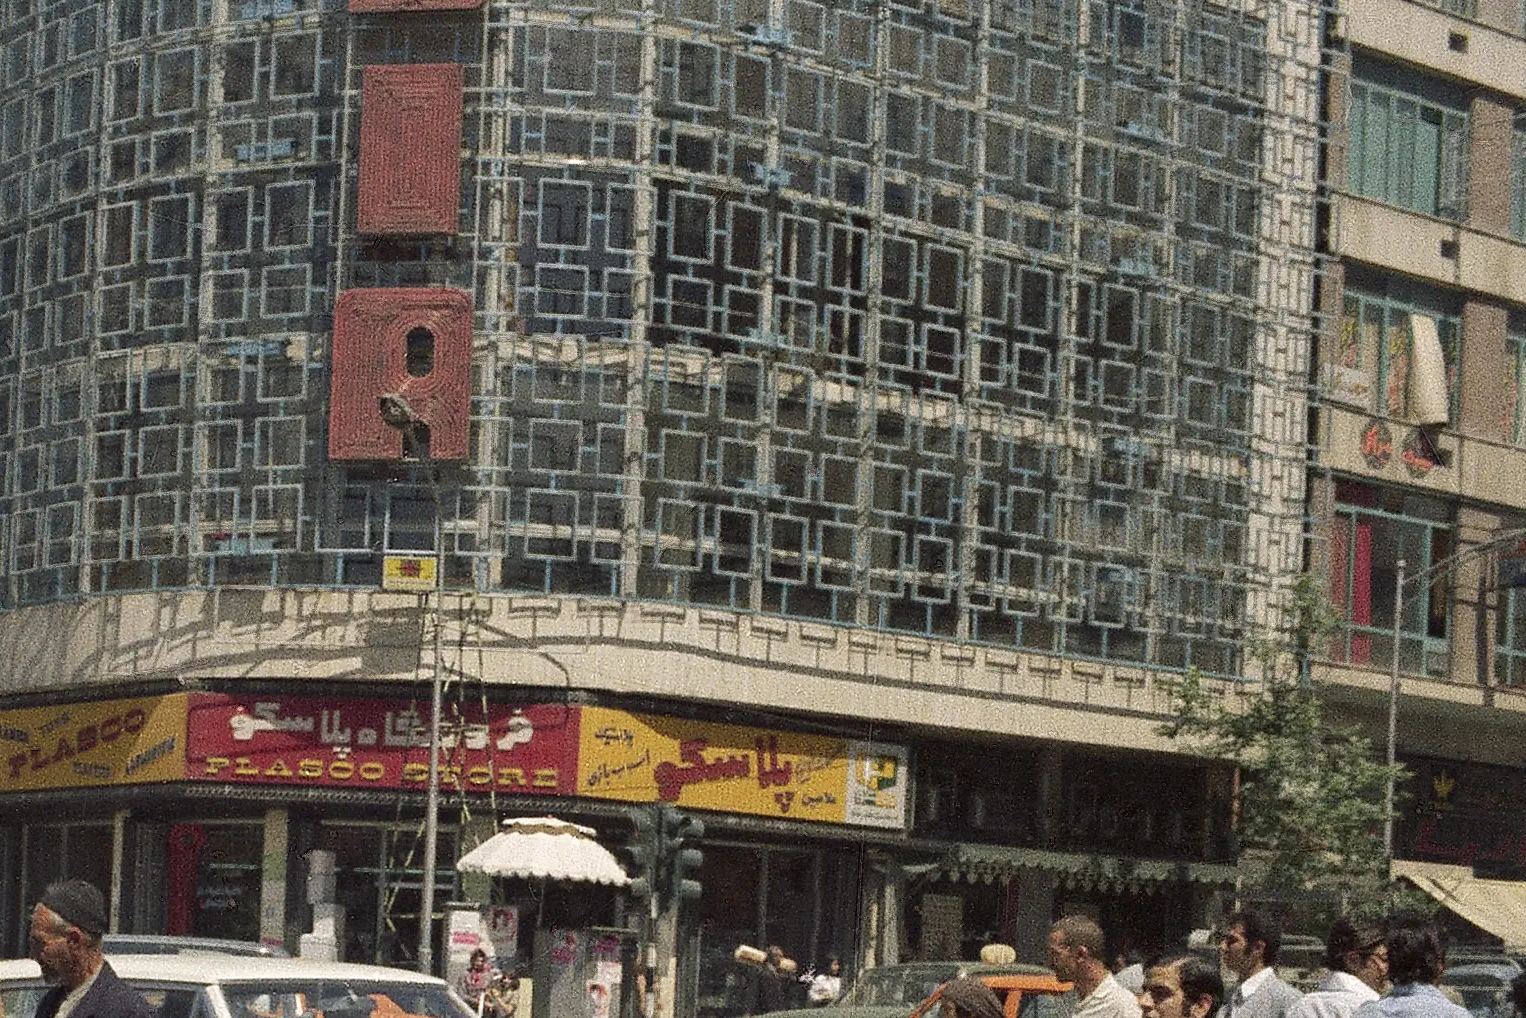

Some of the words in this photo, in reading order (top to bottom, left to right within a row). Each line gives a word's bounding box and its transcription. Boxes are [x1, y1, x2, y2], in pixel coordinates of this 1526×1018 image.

[7, 707, 147, 778] PLASCO
[229, 702, 352, 759] پلاسکو
[205, 755, 385, 781] PLASCO
[403, 762, 559, 789] STORE
[654, 735, 793, 814] پلاسکو
